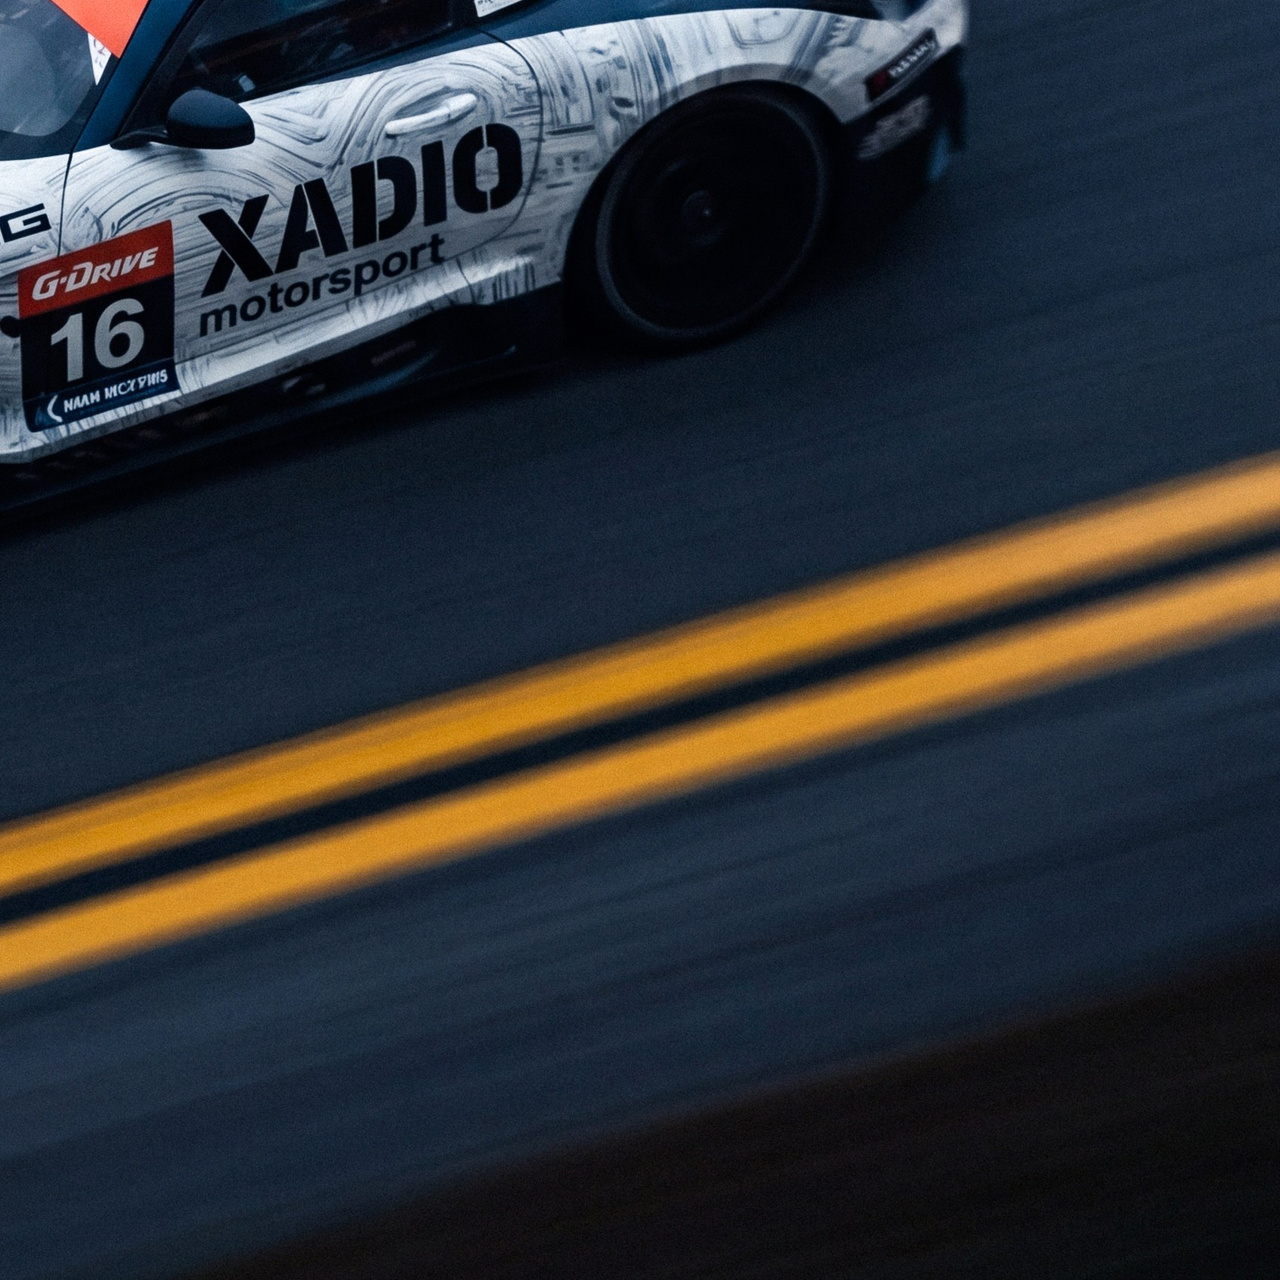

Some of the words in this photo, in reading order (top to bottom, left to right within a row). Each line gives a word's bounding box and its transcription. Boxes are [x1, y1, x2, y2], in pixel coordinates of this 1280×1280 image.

[198, 123, 521, 297] XADIO
[31, 246, 160, 302] G-DRIVE
[198, 233, 445, 338] motorsport
[48, 297, 147, 384] 16
